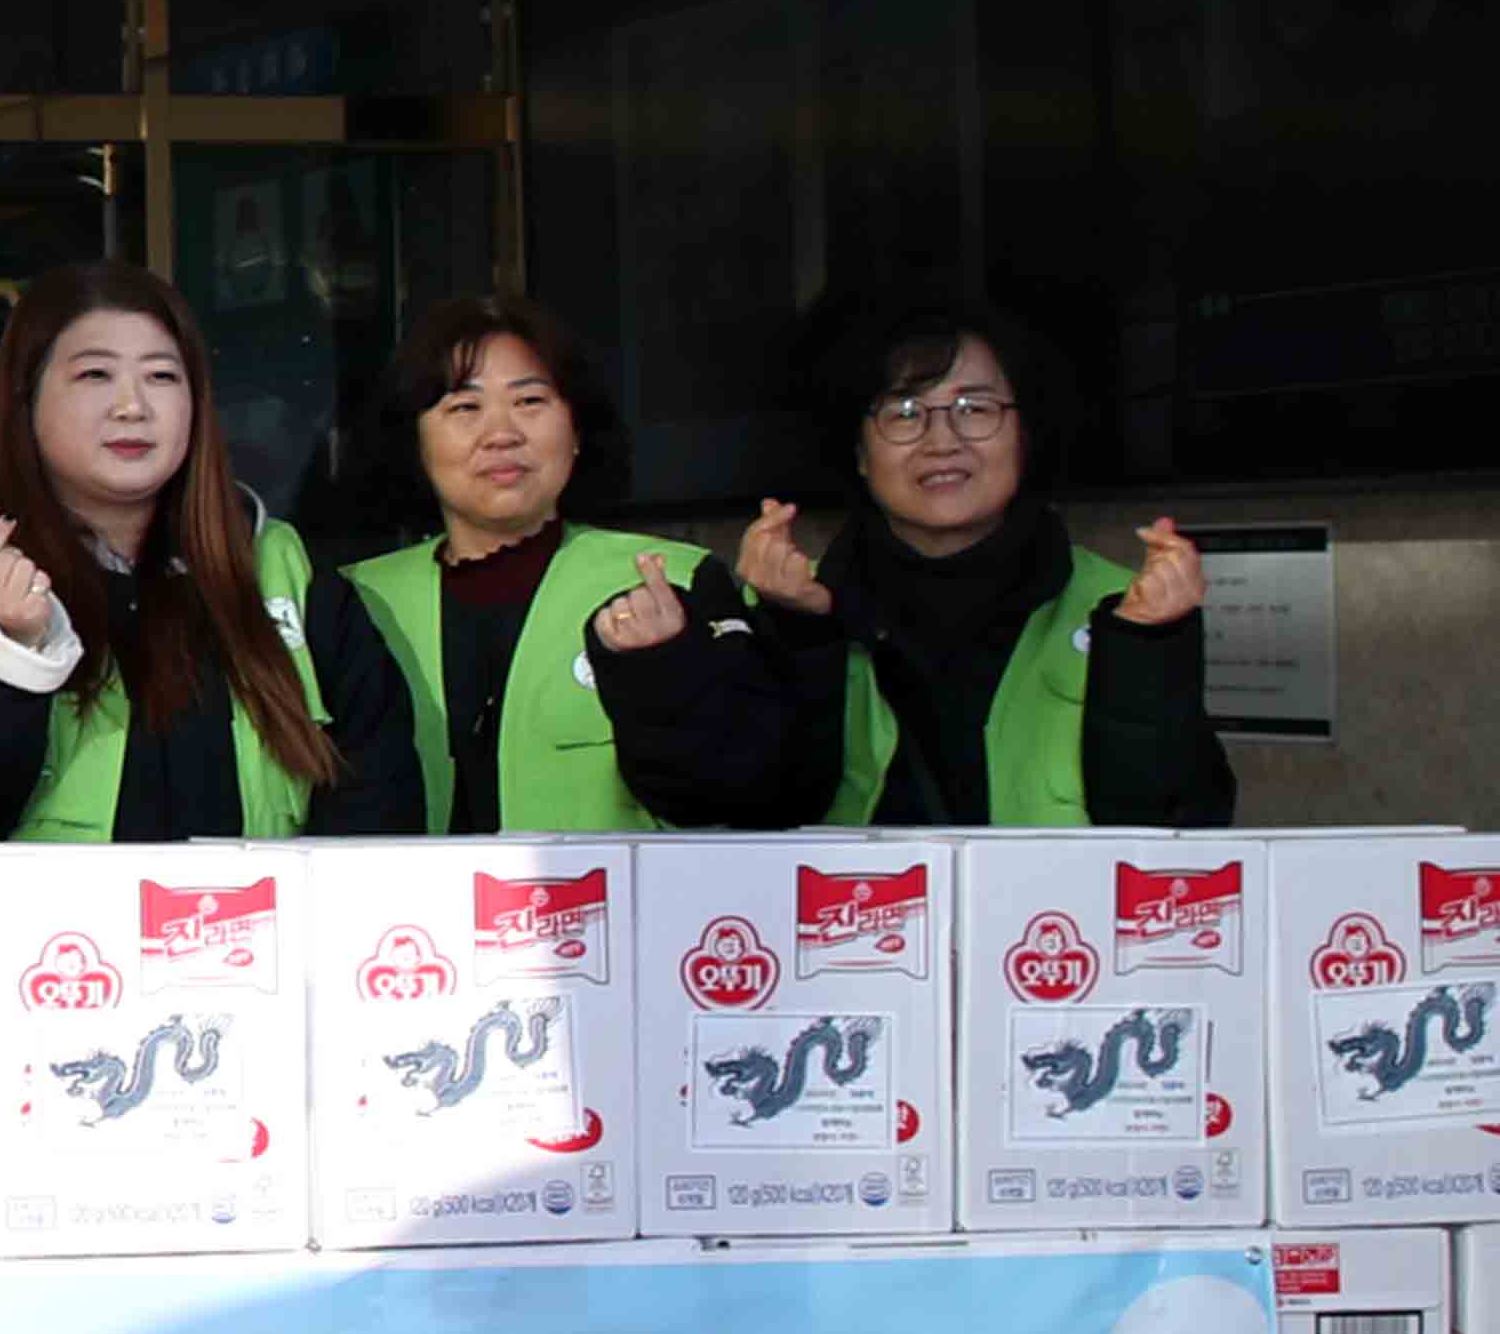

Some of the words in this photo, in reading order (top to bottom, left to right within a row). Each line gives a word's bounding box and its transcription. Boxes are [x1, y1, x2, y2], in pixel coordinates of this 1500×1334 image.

[164, 913, 255, 954] 진라면
[497, 909, 587, 949] 진라면
[818, 902, 907, 948] 진라면
[1134, 897, 1222, 941] 진라면
[372, 968, 441, 998] 오뚜기
[698, 963, 761, 991] 오뚜기
[1021, 959, 1083, 987] 오뚜기
[36, 977, 104, 1010] 오뚜기
